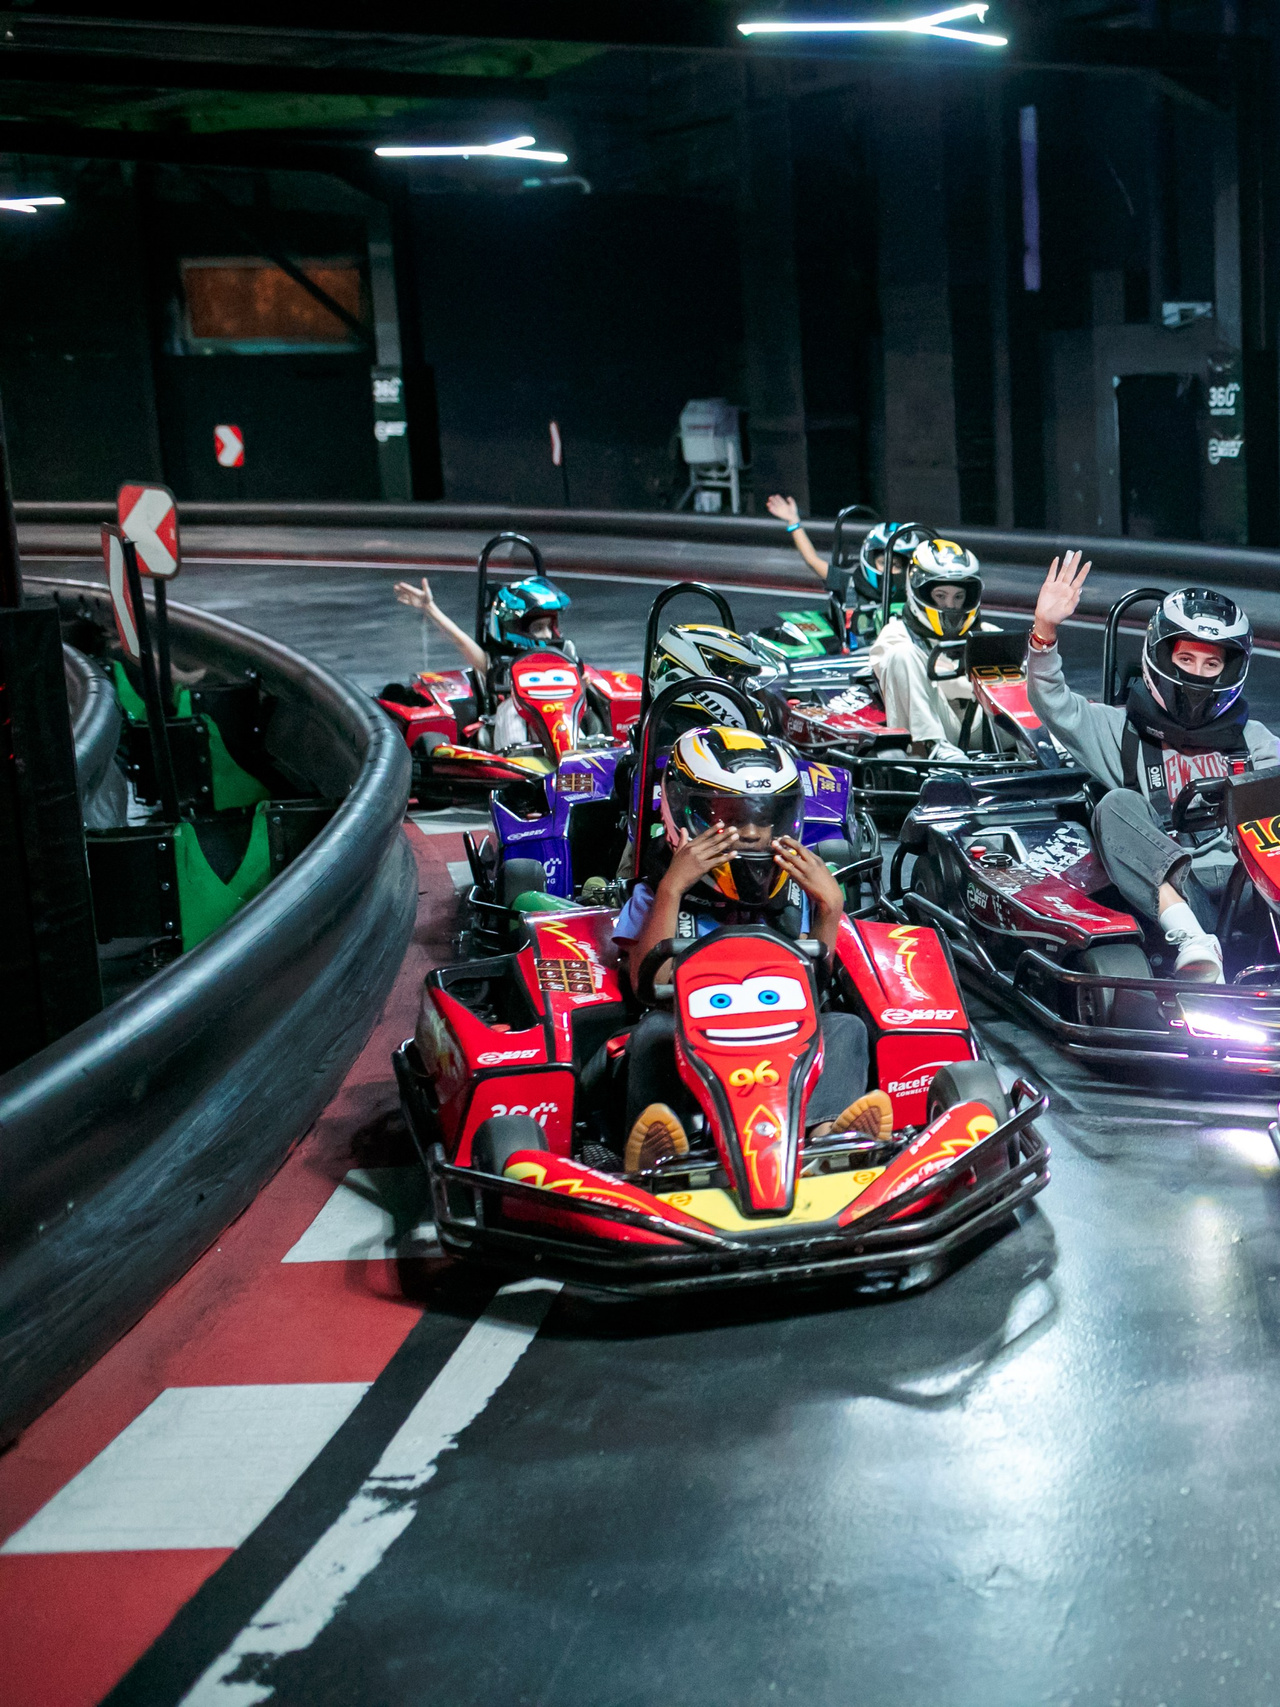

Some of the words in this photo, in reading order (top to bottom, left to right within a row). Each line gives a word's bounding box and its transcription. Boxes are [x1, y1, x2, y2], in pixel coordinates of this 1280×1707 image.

[1208, 385, 1237, 407] 360
[1150, 766, 1163, 788] OMP
[790, 882, 801, 906] OMP
[679, 911, 692, 938] OMP
[729, 1060, 780, 1095] 96
